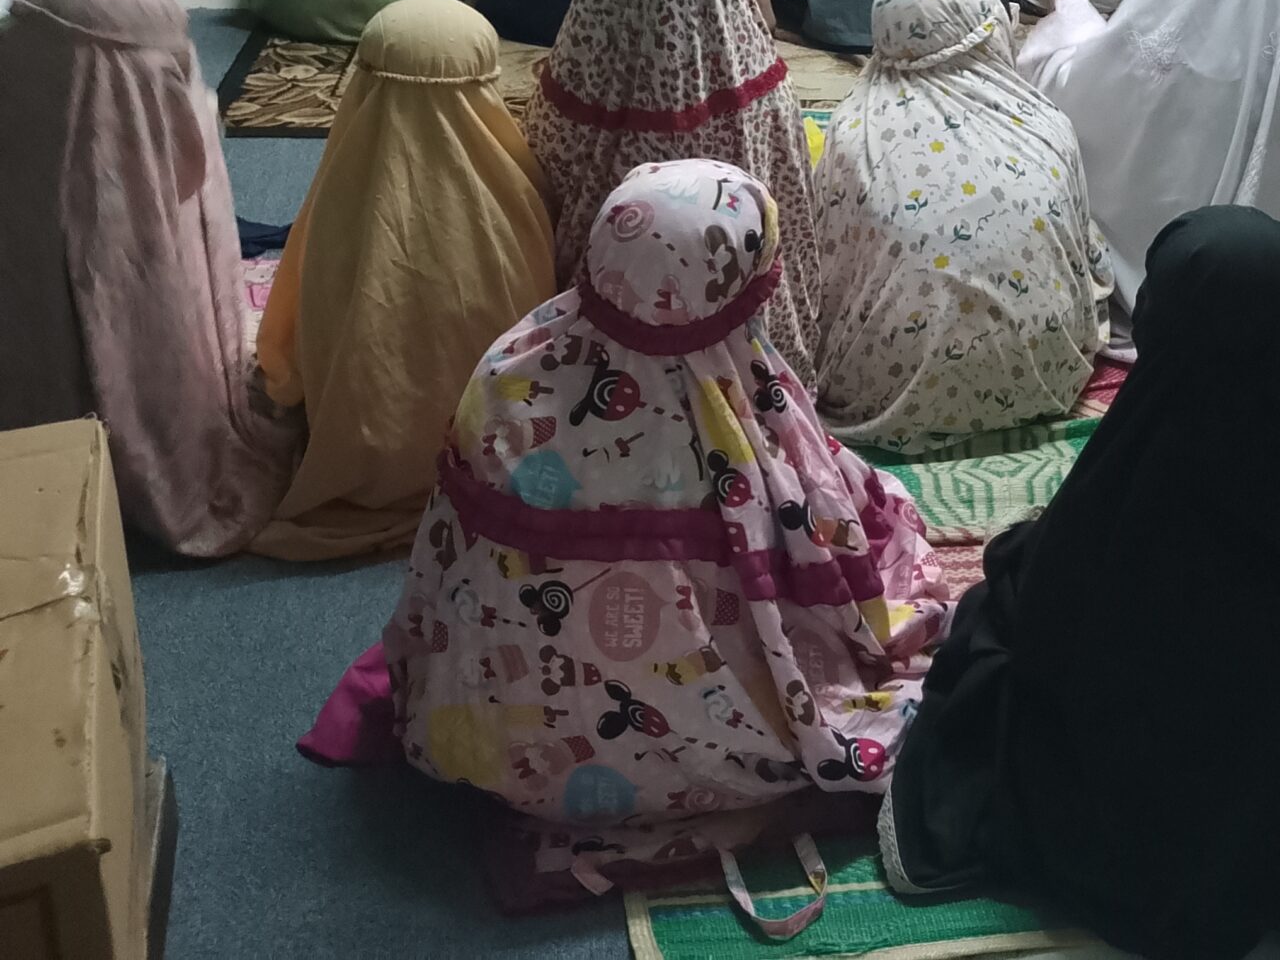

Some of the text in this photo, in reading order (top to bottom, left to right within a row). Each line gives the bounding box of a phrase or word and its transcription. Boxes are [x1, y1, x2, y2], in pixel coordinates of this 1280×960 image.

[605, 586, 621, 648] WE ARE SO
[623, 587, 645, 648] SWEET!
